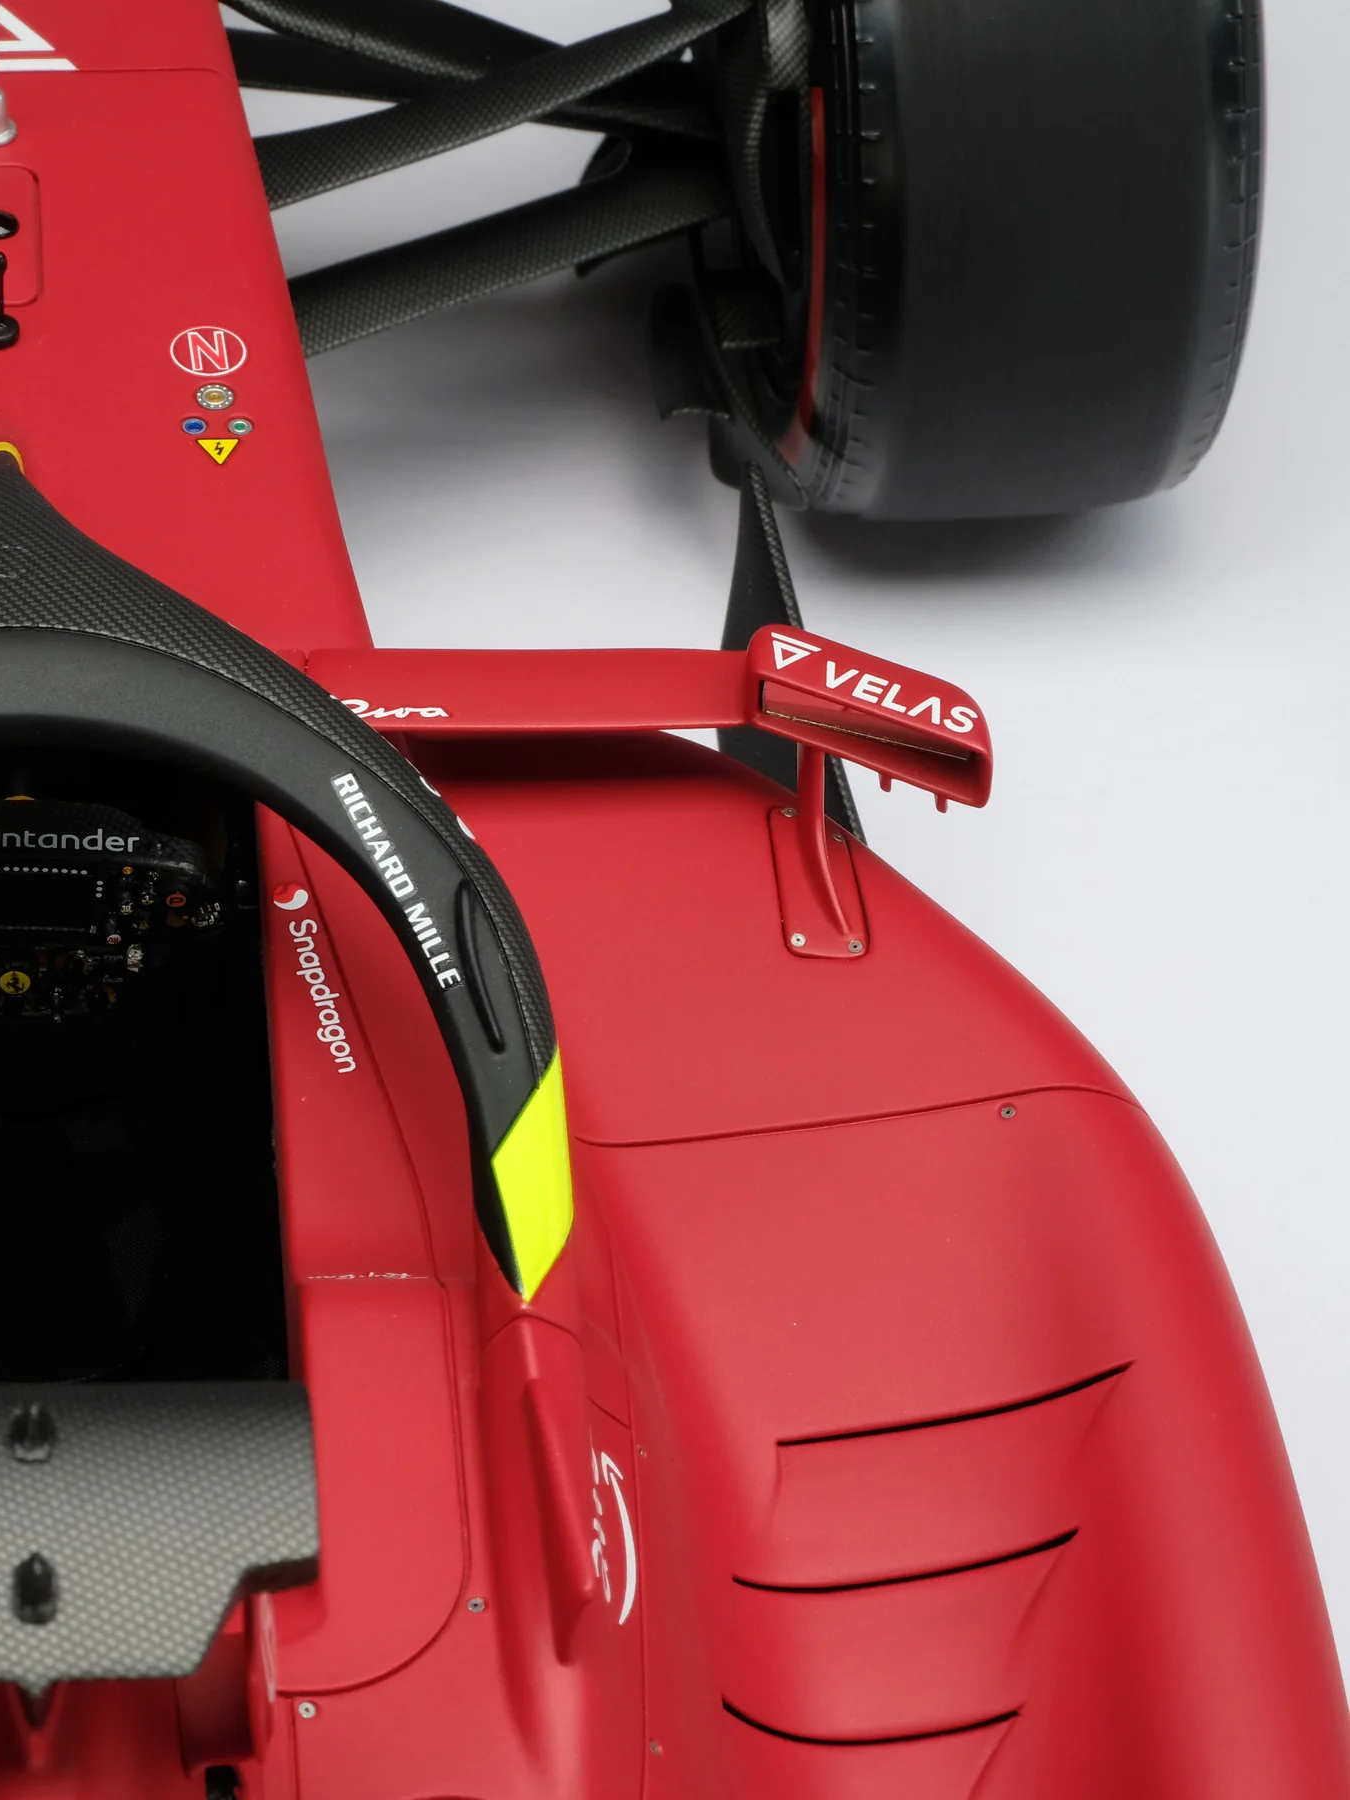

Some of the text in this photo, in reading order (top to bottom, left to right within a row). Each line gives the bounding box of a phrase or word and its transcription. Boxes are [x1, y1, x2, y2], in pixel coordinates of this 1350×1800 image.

[187, 330, 230, 371] N
[825, 660, 979, 734] VELAS
[332, 772, 415, 899] RICHARD
[404, 902, 461, 989] MILLE
[289, 918, 357, 1074] Snapdragon
